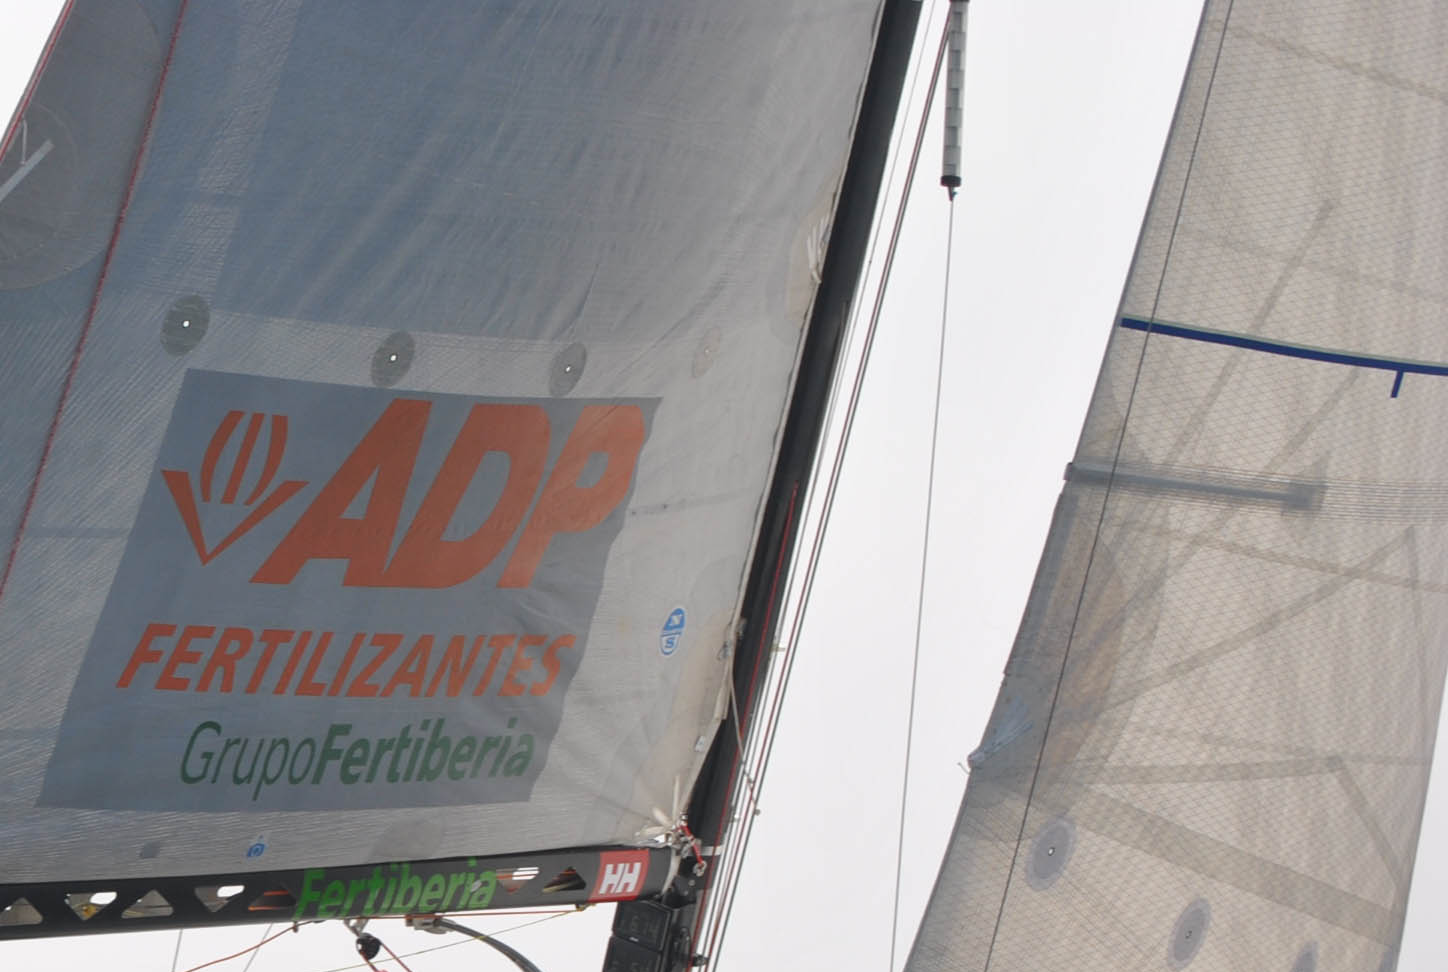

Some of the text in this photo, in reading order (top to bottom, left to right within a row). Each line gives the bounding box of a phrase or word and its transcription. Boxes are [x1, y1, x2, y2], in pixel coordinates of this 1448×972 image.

[248, 398, 646, 588] ADP
[115, 622, 576, 698] FERTILIZANTES
[292, 858, 497, 921] Fertiberia
[599, 862, 642, 894] HH
